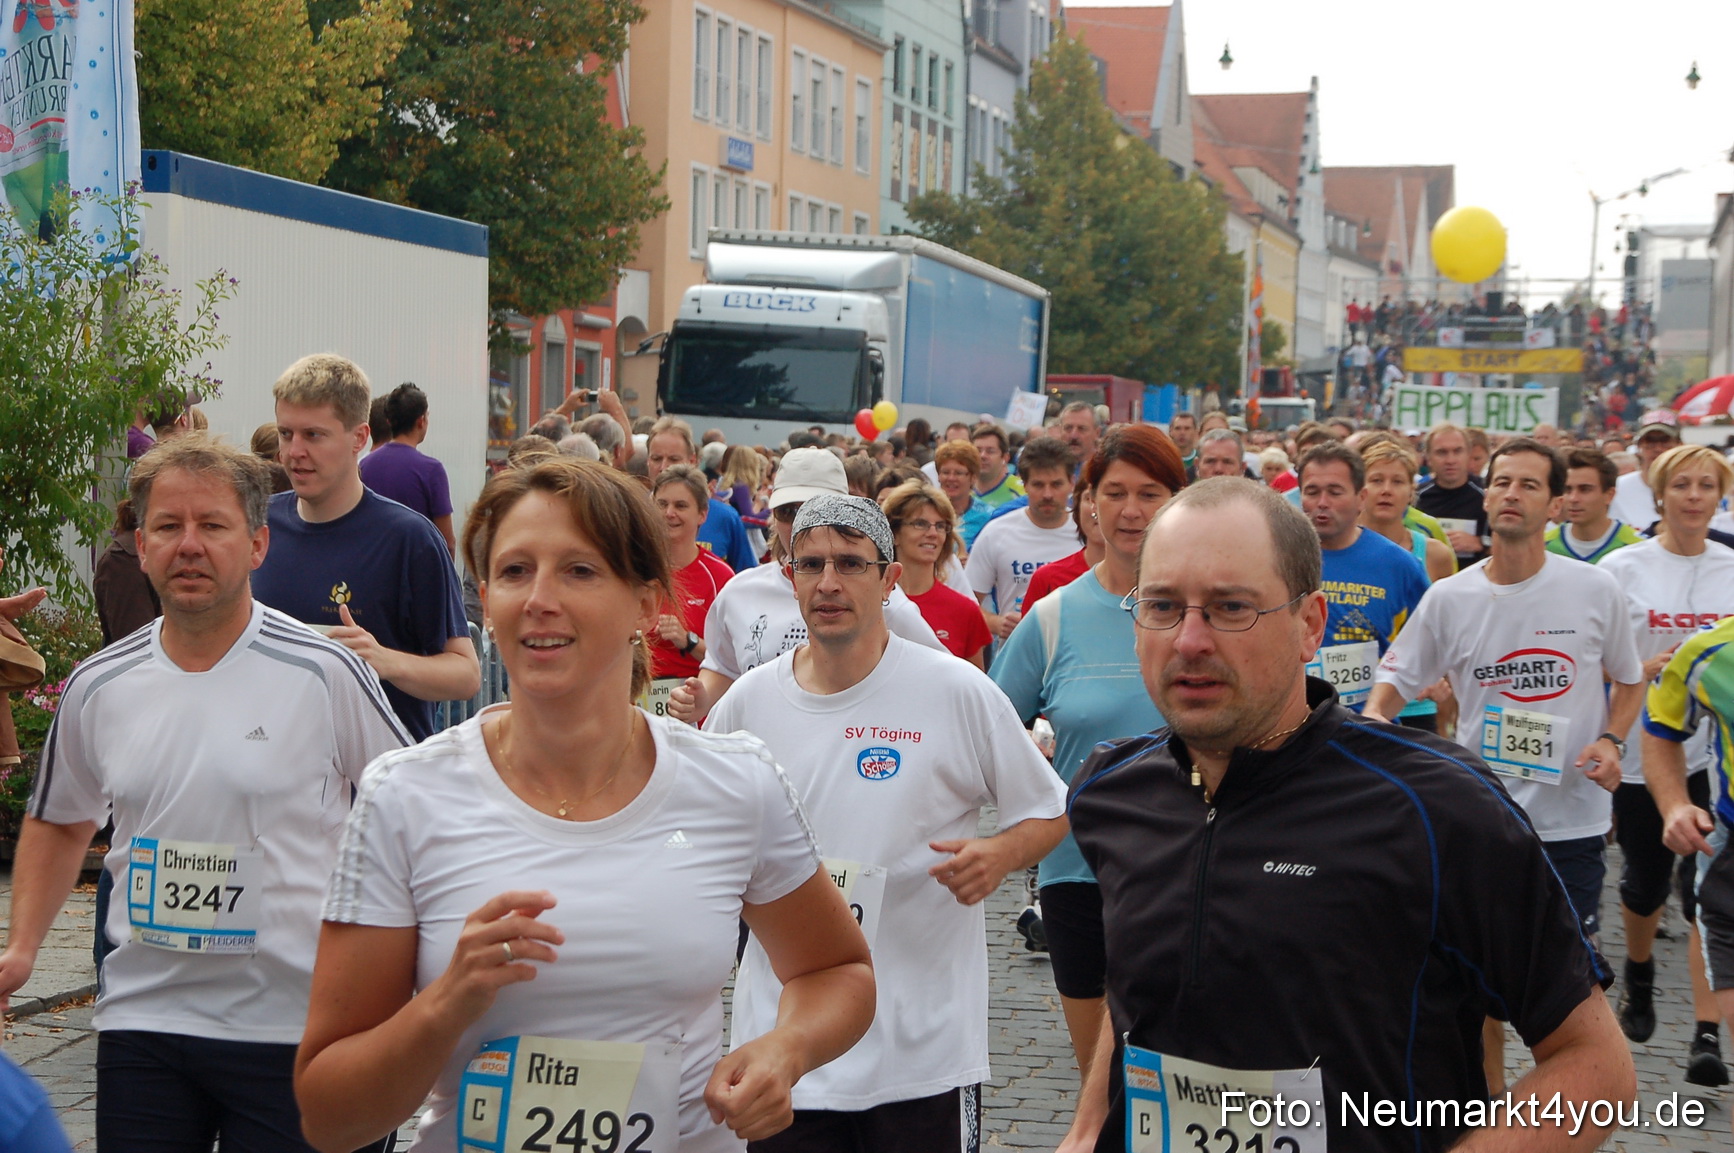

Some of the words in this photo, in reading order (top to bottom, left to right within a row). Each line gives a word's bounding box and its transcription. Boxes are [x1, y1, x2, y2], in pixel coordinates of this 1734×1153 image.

[723, 291, 816, 312] BOCK
[1460, 353, 1520, 368] START
[1399, 389, 1545, 432] APPLAUS
[1326, 653, 1347, 663] Fritz
[1329, 665, 1372, 685] 3268
[1473, 660, 1557, 680] GERHART
[1512, 675, 1569, 690] JANIG
[845, 727, 865, 739] SV
[870, 727, 922, 743] Töging
[1506, 734, 1553, 758] 3431
[163, 848, 237, 873] Christian
[136, 876, 143, 891] C
[164, 881, 245, 914] 3247
[527, 1052, 579, 1086] Rita
[473, 1098, 486, 1121] C
[521, 1106, 655, 1153] 2492
[1140, 1113, 1150, 1135] C
